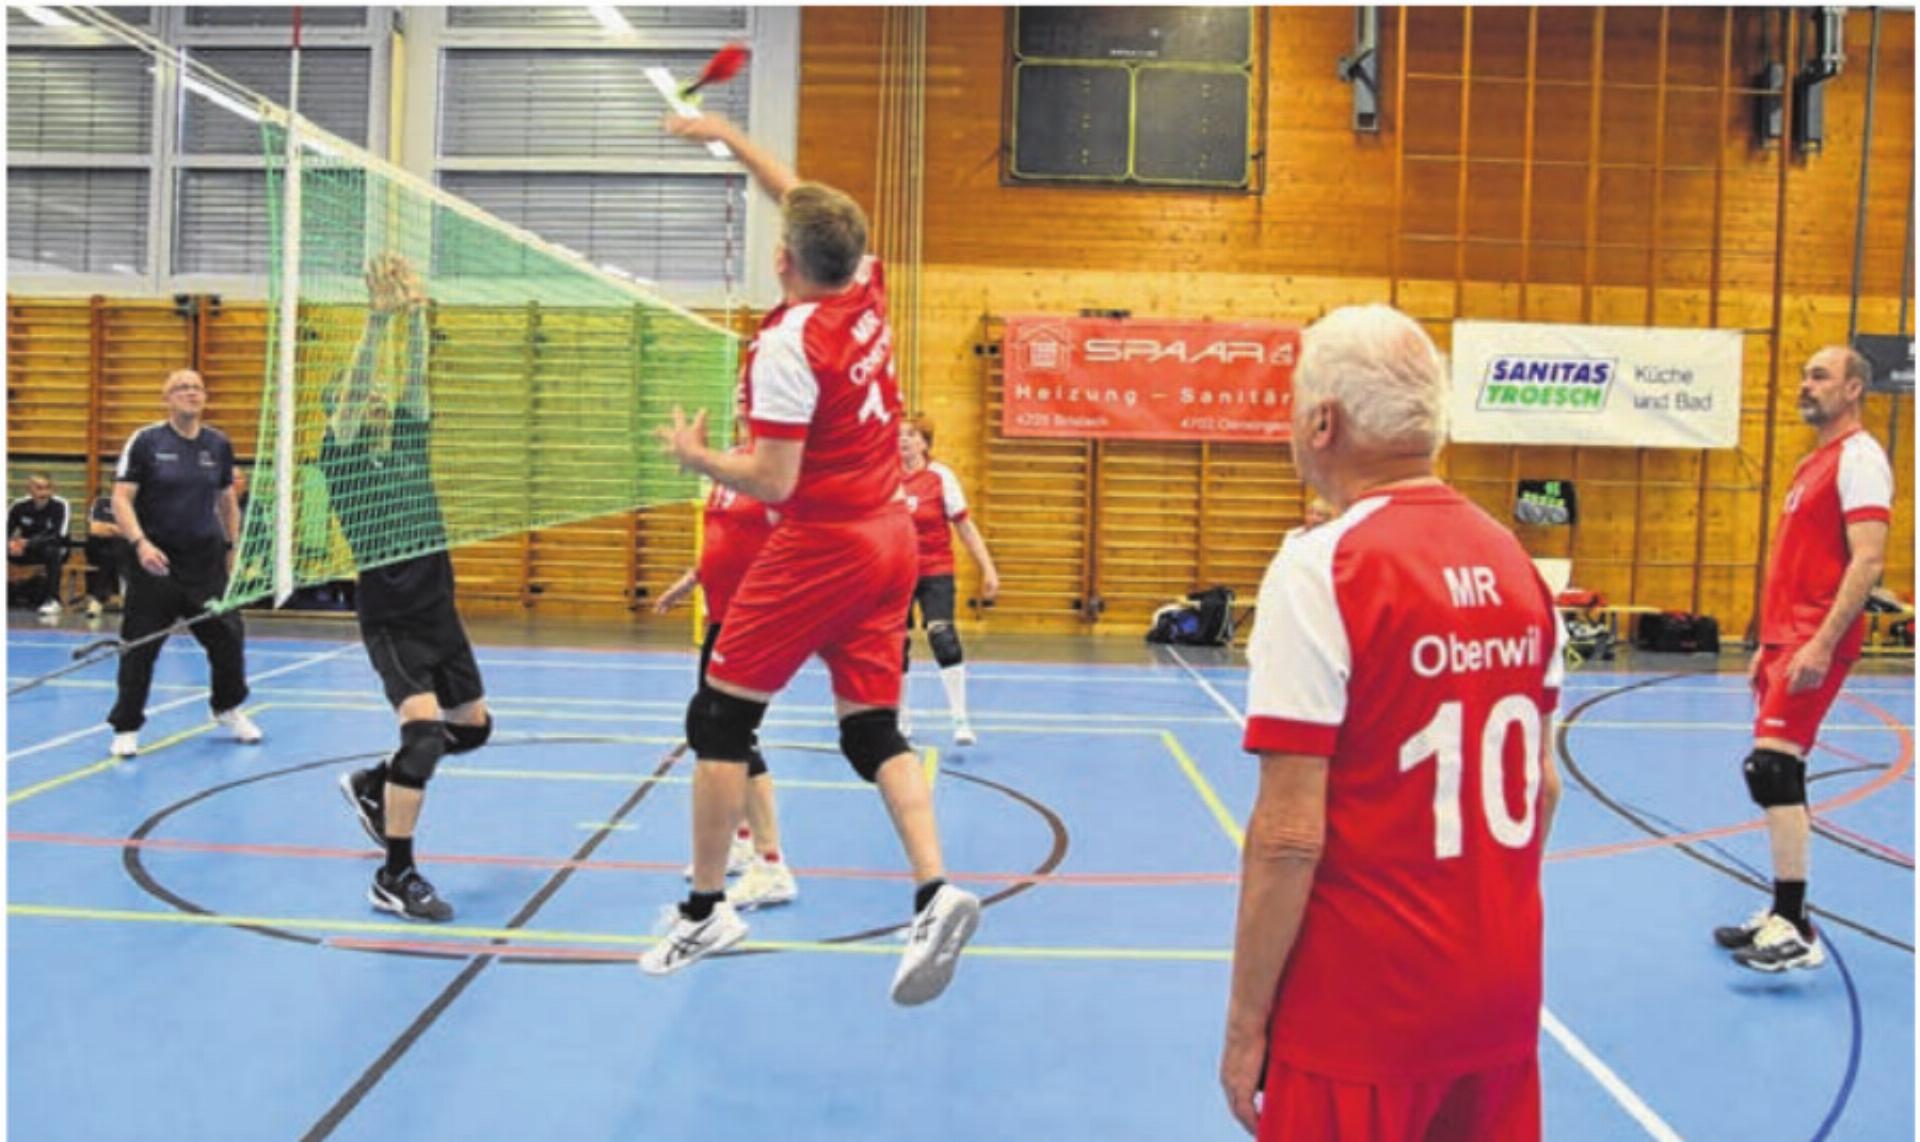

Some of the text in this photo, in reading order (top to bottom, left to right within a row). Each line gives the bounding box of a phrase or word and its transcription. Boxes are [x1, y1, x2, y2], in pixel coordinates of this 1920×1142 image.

[1083, 338, 1265, 365] SPAAR
[1492, 359, 1610, 385] SANITAS
[1634, 364, 1695, 385] Küche
[1015, 384, 1138, 407] Heizung
[1179, 386, 1292, 407] Sanitär
[1486, 384, 1602, 407] TROESCH
[1633, 391, 1712, 412] und Bad
[1443, 565, 1502, 608] MR
[1410, 625, 1542, 678] Oberwil
[1399, 693, 1542, 861] 10
